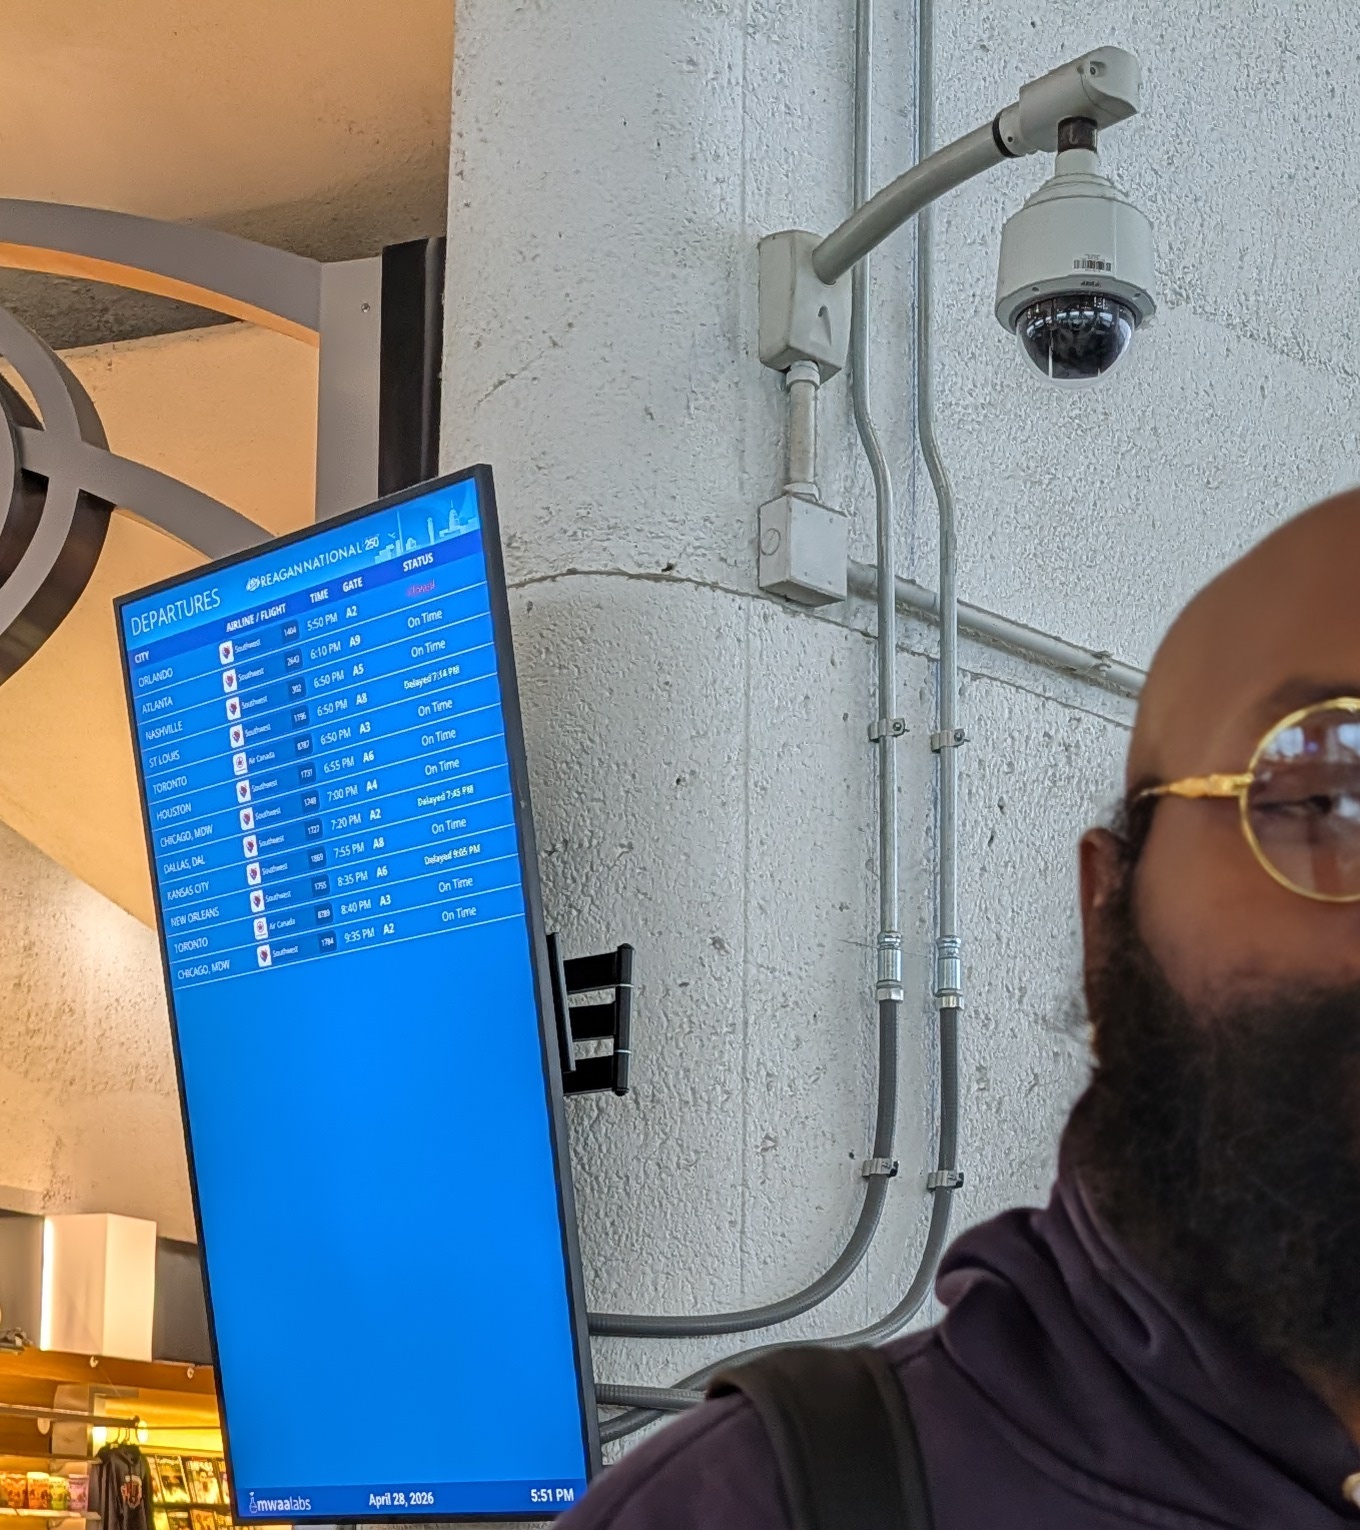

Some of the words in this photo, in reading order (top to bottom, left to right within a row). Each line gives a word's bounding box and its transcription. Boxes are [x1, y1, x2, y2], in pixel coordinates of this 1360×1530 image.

[364, 536, 379, 550] 250
[402, 552, 433, 571] STATUS
[342, 576, 362, 592] GATE
[309, 588, 328, 603] TIME
[131, 588, 220, 635] DEPARTURES
[226, 614, 254, 632] AIRLINE
[260, 603, 285, 620] FLIGHT
[346, 605, 357, 618] A2
[407, 616, 420, 628] On
[421, 610, 442, 623] Time
[307, 616, 323, 631] 5:50
[324, 612, 337, 625] PM
[234, 638, 261, 653] Southwest
[349, 634, 360, 647] A9
[411, 646, 424, 657] On
[424, 640, 445, 653] Time
[134, 650, 149, 663] CITY
[310, 645, 327, 659] 6:10
[328, 640, 341, 653] PM
[138, 667, 173, 687] ORLANDO
[237, 667, 264, 682] Southwest
[352, 663, 364, 676] A5
[313, 674, 330, 688] 6:50
[331, 669, 344, 682] PM
[403, 673, 432, 689] Delayed
[142, 696, 173, 714] ATLANTA
[240, 695, 267, 709] Southwest
[356, 692, 367, 705] A8
[317, 702, 333, 716] 6:50
[334, 698, 347, 711] PM
[417, 705, 430, 716] On
[431, 699, 452, 712] Time
[145, 720, 182, 740] NASHVILLE
[244, 723, 271, 737] Southwest
[359, 721, 370, 734] A3
[320, 731, 337, 745] 6:50
[338, 727, 351, 739] PM
[421, 735, 434, 746] On
[435, 729, 456, 741] Time
[148, 756, 157, 768] ST
[158, 749, 180, 765] LOUIS
[323, 759, 340, 773] 6:55
[341, 755, 354, 768] PM
[362, 750, 374, 762] A6
[424, 764, 437, 775] On
[438, 759, 459, 771] Time
[152, 775, 187, 793] TORONTO
[251, 779, 277, 792] Southwest
[366, 779, 377, 791] A4
[327, 788, 344, 801] 7:00
[344, 784, 358, 796] PM
[417, 792, 445, 806] Delayed
[156, 802, 191, 820] HOUSTON
[254, 807, 281, 821] Southwest
[369, 808, 381, 820] A2
[330, 816, 347, 829] 7:20
[348, 813, 361, 825] PM
[431, 823, 444, 834] On
[445, 818, 466, 830] Time
[160, 830, 193, 847] CHICAGO,
[193, 824, 212, 838] MDW
[258, 835, 284, 847] Southwest
[373, 837, 384, 849] A8
[333, 844, 350, 858] 7:55
[351, 841, 364, 853] PM
[424, 850, 452, 865] Delayed
[163, 858, 191, 874] DALLAS,
[191, 855, 205, 866] DAL
[261, 863, 288, 875] Southwest
[376, 865, 387, 877] A6
[337, 873, 354, 886] 8:35
[355, 870, 368, 882] PM
[438, 881, 451, 892] On
[452, 877, 472, 888] Time
[167, 885, 194, 900] KANSAS
[194, 881, 209, 893] CITY
[264, 890, 291, 902] Southwest
[340, 901, 357, 914] 8:40
[358, 898, 371, 910] PM
[379, 894, 391, 906] A3
[170, 915, 186, 926] NEW
[187, 906, 219, 922] ORLEANS
[441, 910, 454, 921] On
[455, 907, 476, 918] Time
[344, 930, 361, 943] 9:35
[361, 927, 374, 938] PM
[383, 923, 394, 934] A2
[174, 937, 208, 953] TORONTO
[272, 945, 298, 957] Southwest
[177, 964, 210, 979] CHICAGO,
[211, 959, 229, 972] MDW
[368, 1492, 391, 1507] April
[392, 1492, 407, 1507] 28,
[409, 1491, 434, 1504] 2026
[530, 1488, 552, 1502] 5:51
[555, 1488, 574, 1501] PM
[257, 1496, 311, 1512] mwaalabs
